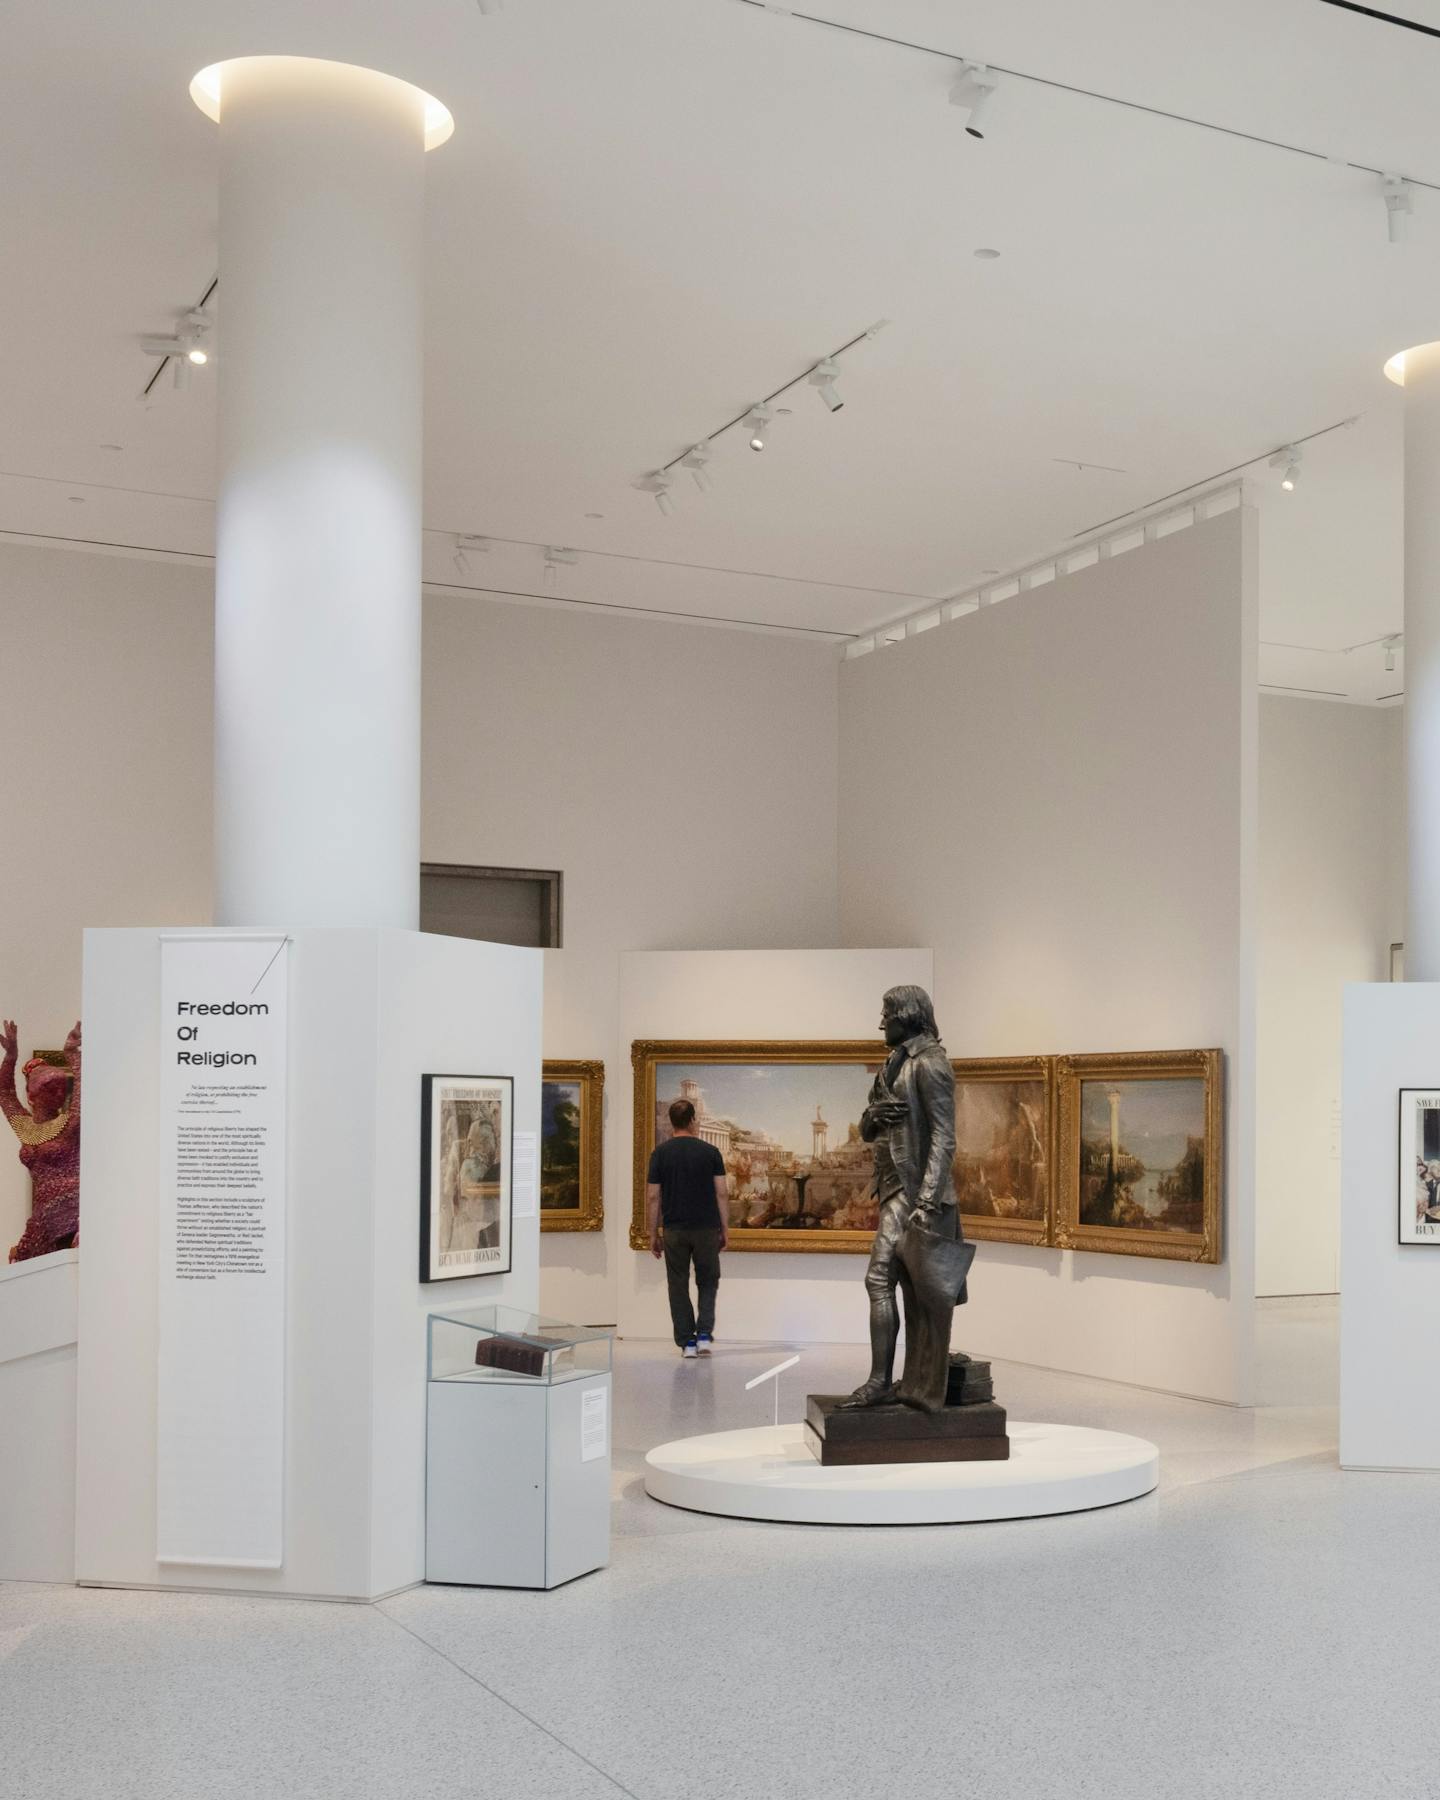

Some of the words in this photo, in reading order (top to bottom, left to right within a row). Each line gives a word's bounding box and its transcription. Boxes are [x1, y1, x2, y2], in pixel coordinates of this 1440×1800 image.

[177, 1001, 269, 1015] Freedom
[177, 1026, 198, 1041] Of
[177, 1051, 257, 1068] Religion
[1416, 1099, 1433, 1107] SAVE
[1415, 1225, 1435, 1235] BUY
[474, 1249, 501, 1263] BONDS
